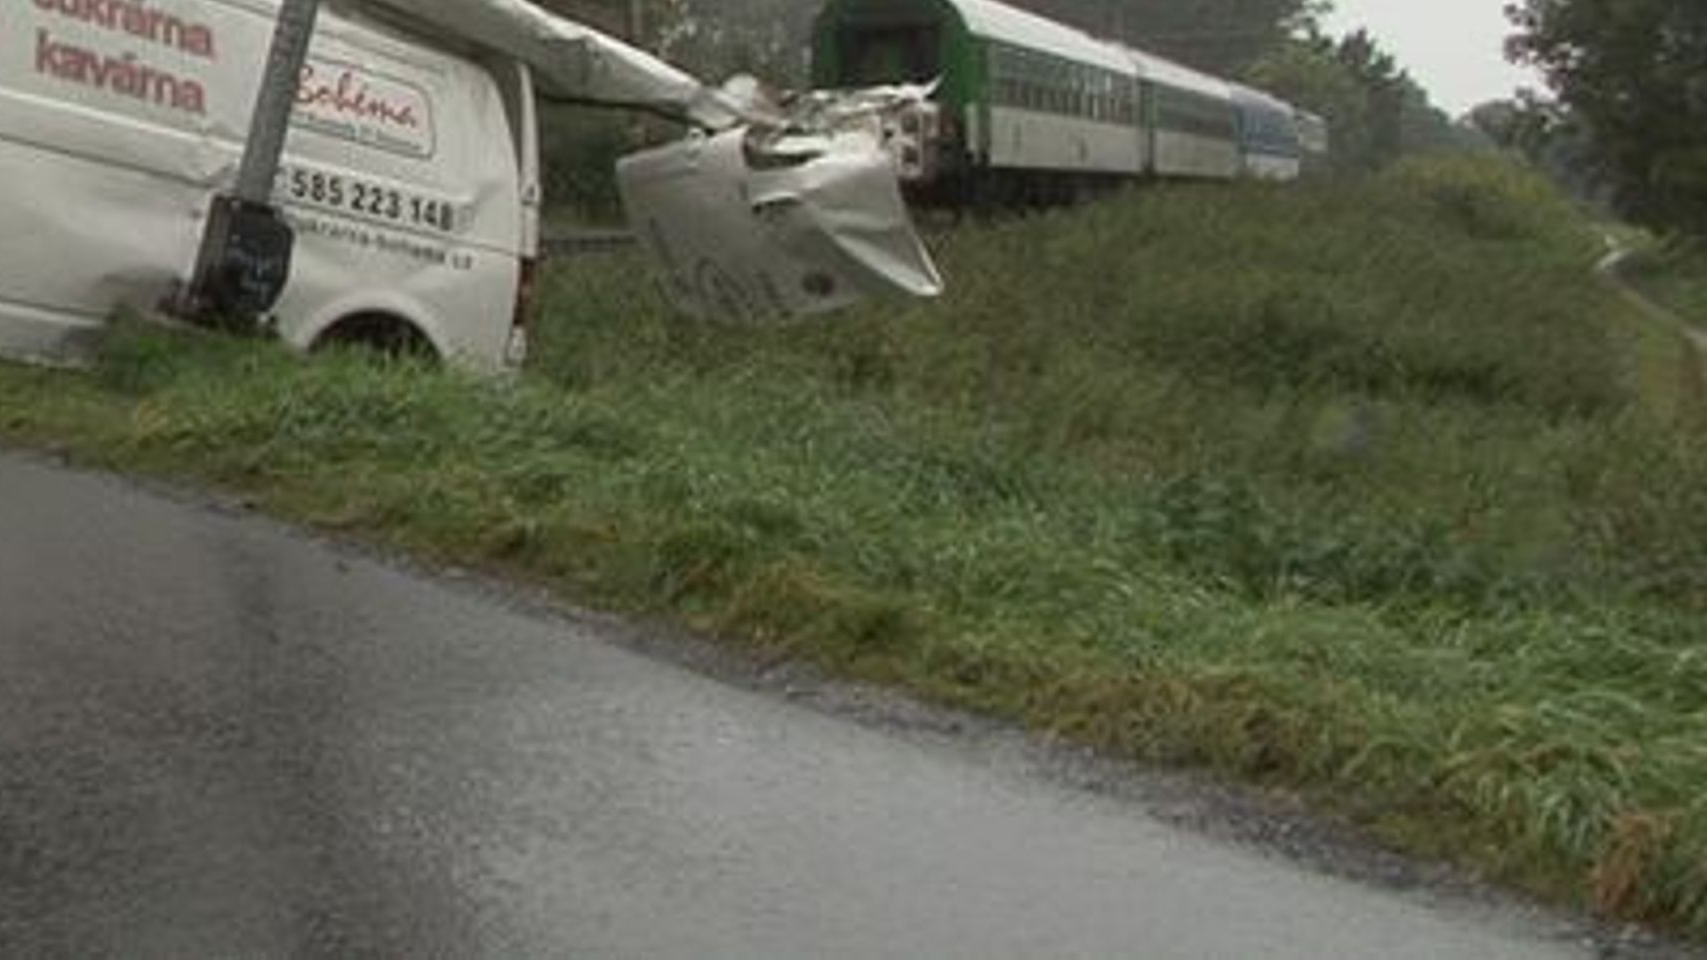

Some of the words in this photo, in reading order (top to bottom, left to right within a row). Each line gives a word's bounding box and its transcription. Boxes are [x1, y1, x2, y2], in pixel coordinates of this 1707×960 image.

[35, 26, 208, 117] kavárna
[291, 170, 344, 207] 585
[350, 183, 400, 219] 223
[411, 197, 453, 232] 148
